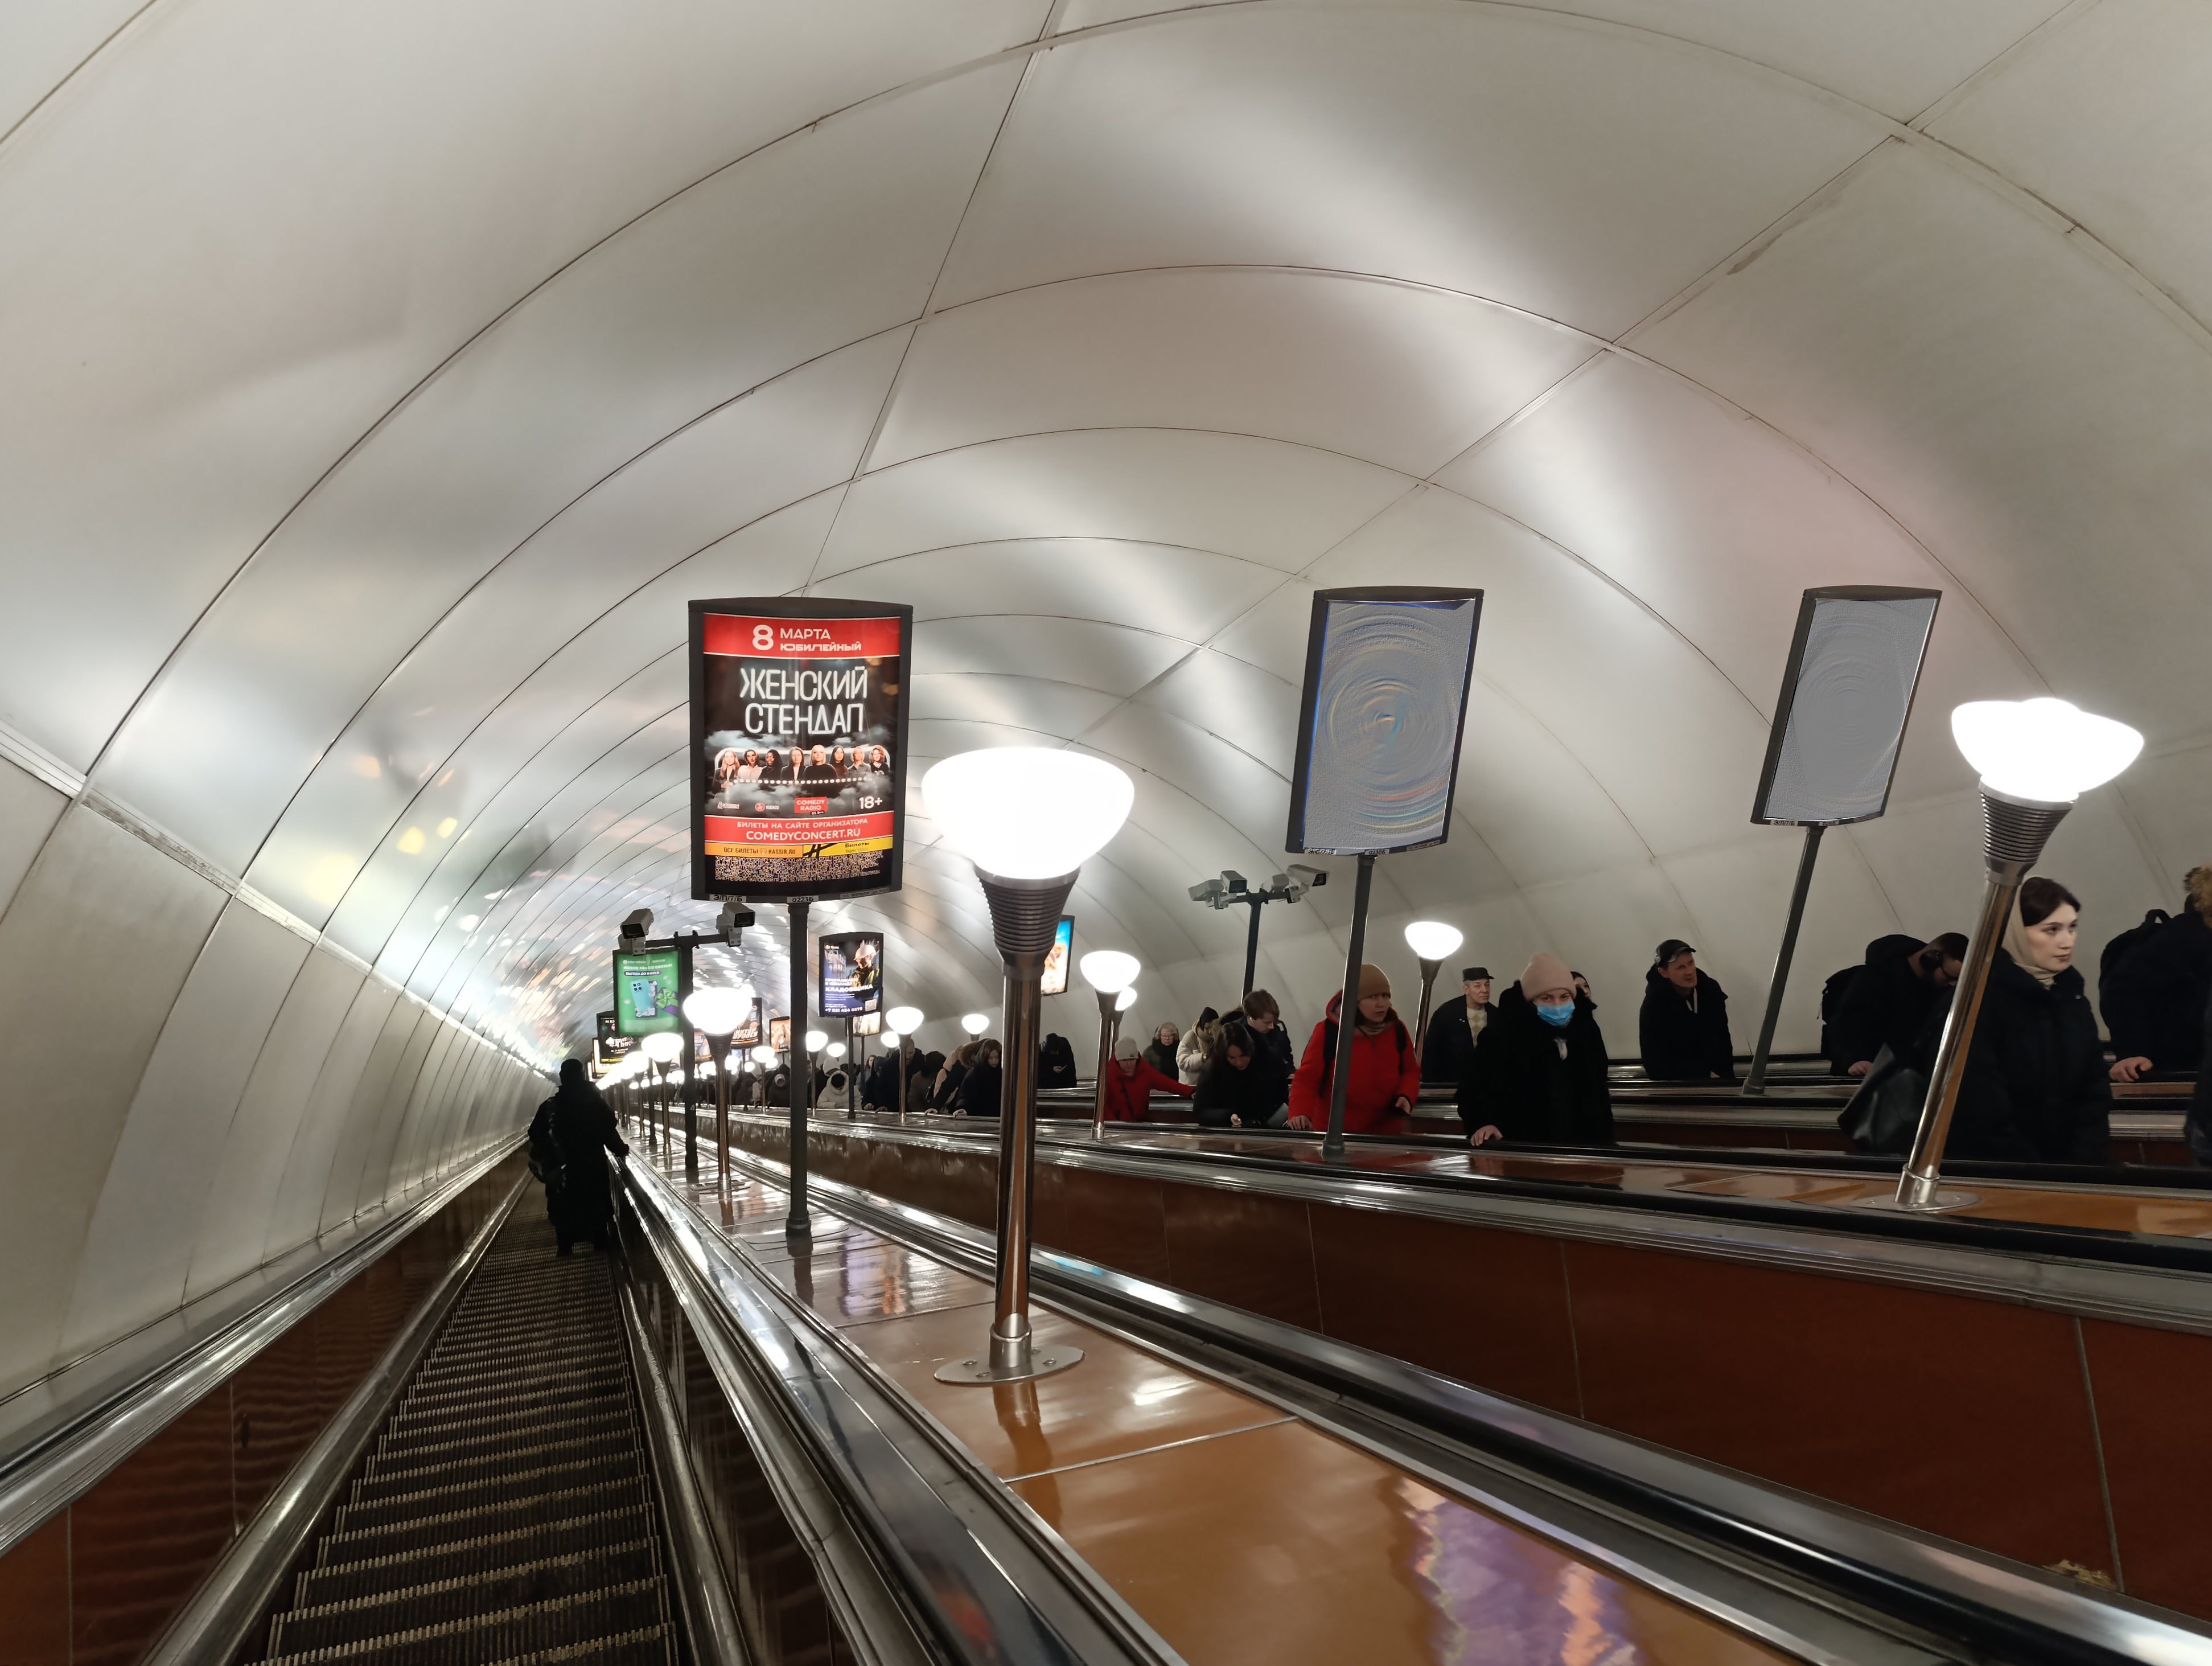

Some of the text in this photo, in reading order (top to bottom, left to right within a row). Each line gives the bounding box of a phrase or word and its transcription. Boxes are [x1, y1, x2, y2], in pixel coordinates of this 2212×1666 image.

[752, 625, 831, 650] 8 МАРТА
[780, 641, 862, 651] ЮБИЛЕЙНЫЙ
[739, 666, 867, 701] ЖЕНСКИЙ
[745, 703, 864, 734] СТЕНДАП
[859, 796, 883, 809] 18+
[813, 818, 868, 828] ОРГАНИЗАТОРА
[746, 828, 861, 841] COMEDYCONCERT.RU
[825, 984, 873, 993] КЛАДОВЩИКА
